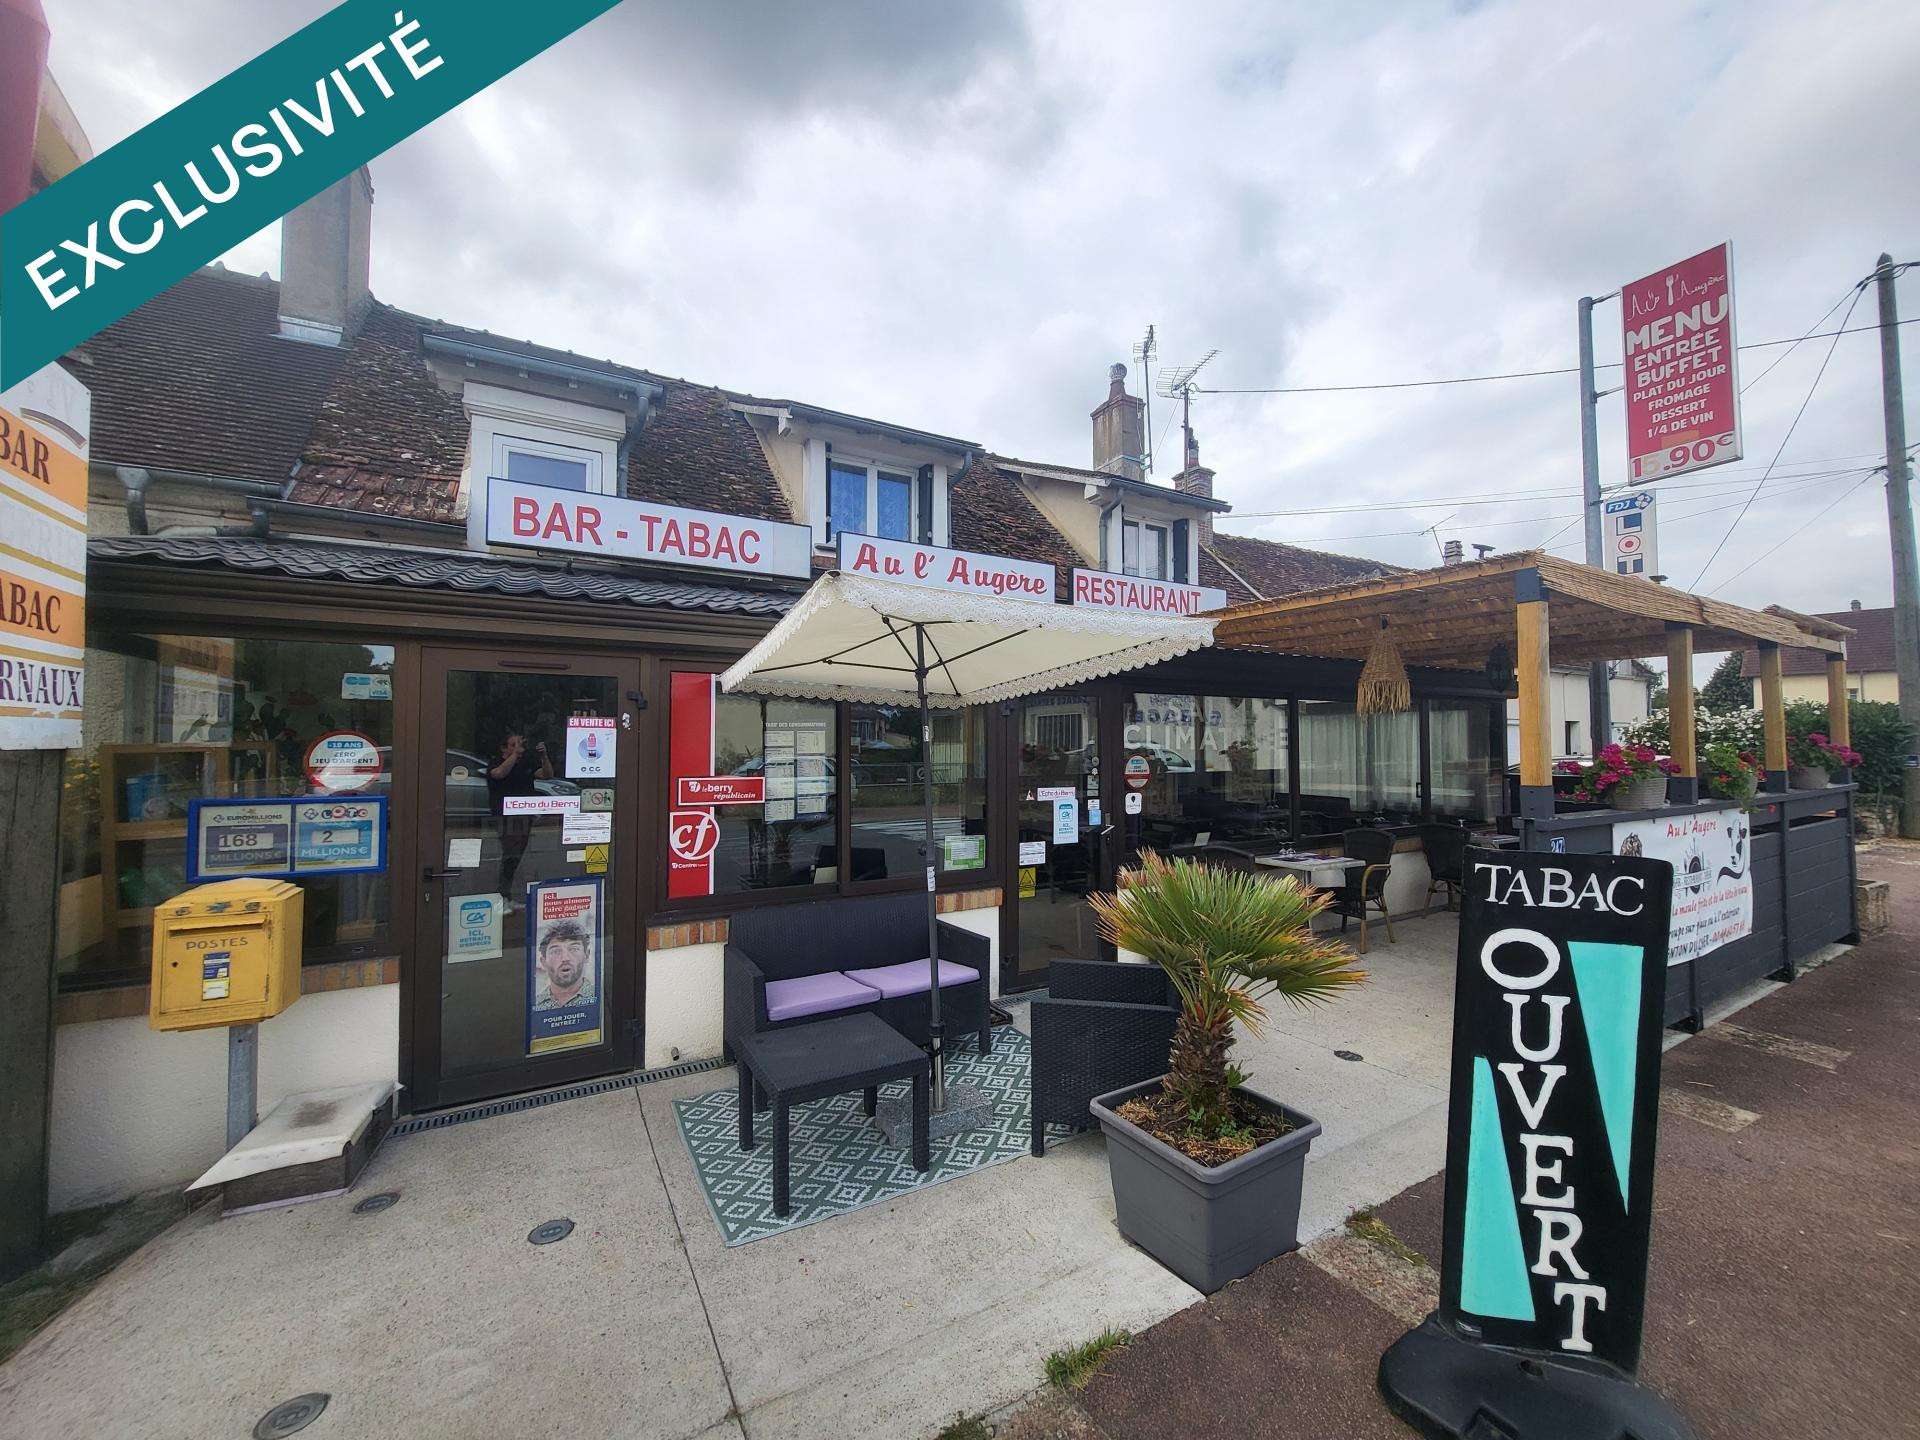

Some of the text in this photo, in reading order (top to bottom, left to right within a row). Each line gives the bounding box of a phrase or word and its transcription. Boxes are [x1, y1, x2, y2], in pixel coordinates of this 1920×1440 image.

[1627, 293, 1729, 356] MENU
[1634, 327, 1720, 372] ENTRÉE
[1637, 345, 1722, 388] BUFFET
[1633, 364, 1727, 403] PLAT DU JOUR
[1648, 383, 1711, 411] FROMAGE
[1648, 410, 1714, 438] 1/4 DE VIN
[1652, 398, 1708, 424] DESSERT
[0, 415, 50, 485] BAR
[1608, 501, 1631, 513] FDJ
[513, 496, 603, 546] BAR
[639, 514, 761, 565] TABAC
[853, 542, 1048, 595] Au l' Augère
[1076, 574, 1202, 617] RESTAURANT
[569, 717, 614, 728] EN VENTE ICI
[707, 784, 734, 793] berry
[713, 792, 756, 800] républicain
[538, 801, 550, 809] du
[551, 800, 579, 809] Berry
[218, 833, 257, 847] 168
[322, 830, 333, 843] 2
[1667, 823, 1681, 838] Au
[209, 851, 272, 862] MILLIONS
[301, 847, 357, 857] MILLIONS
[1551, 839, 1563, 853] 247
[1475, 862, 1645, 917] TABAC
[186, 937, 248, 950] POSTES
[1480, 928, 1606, 1352] OUVERT
